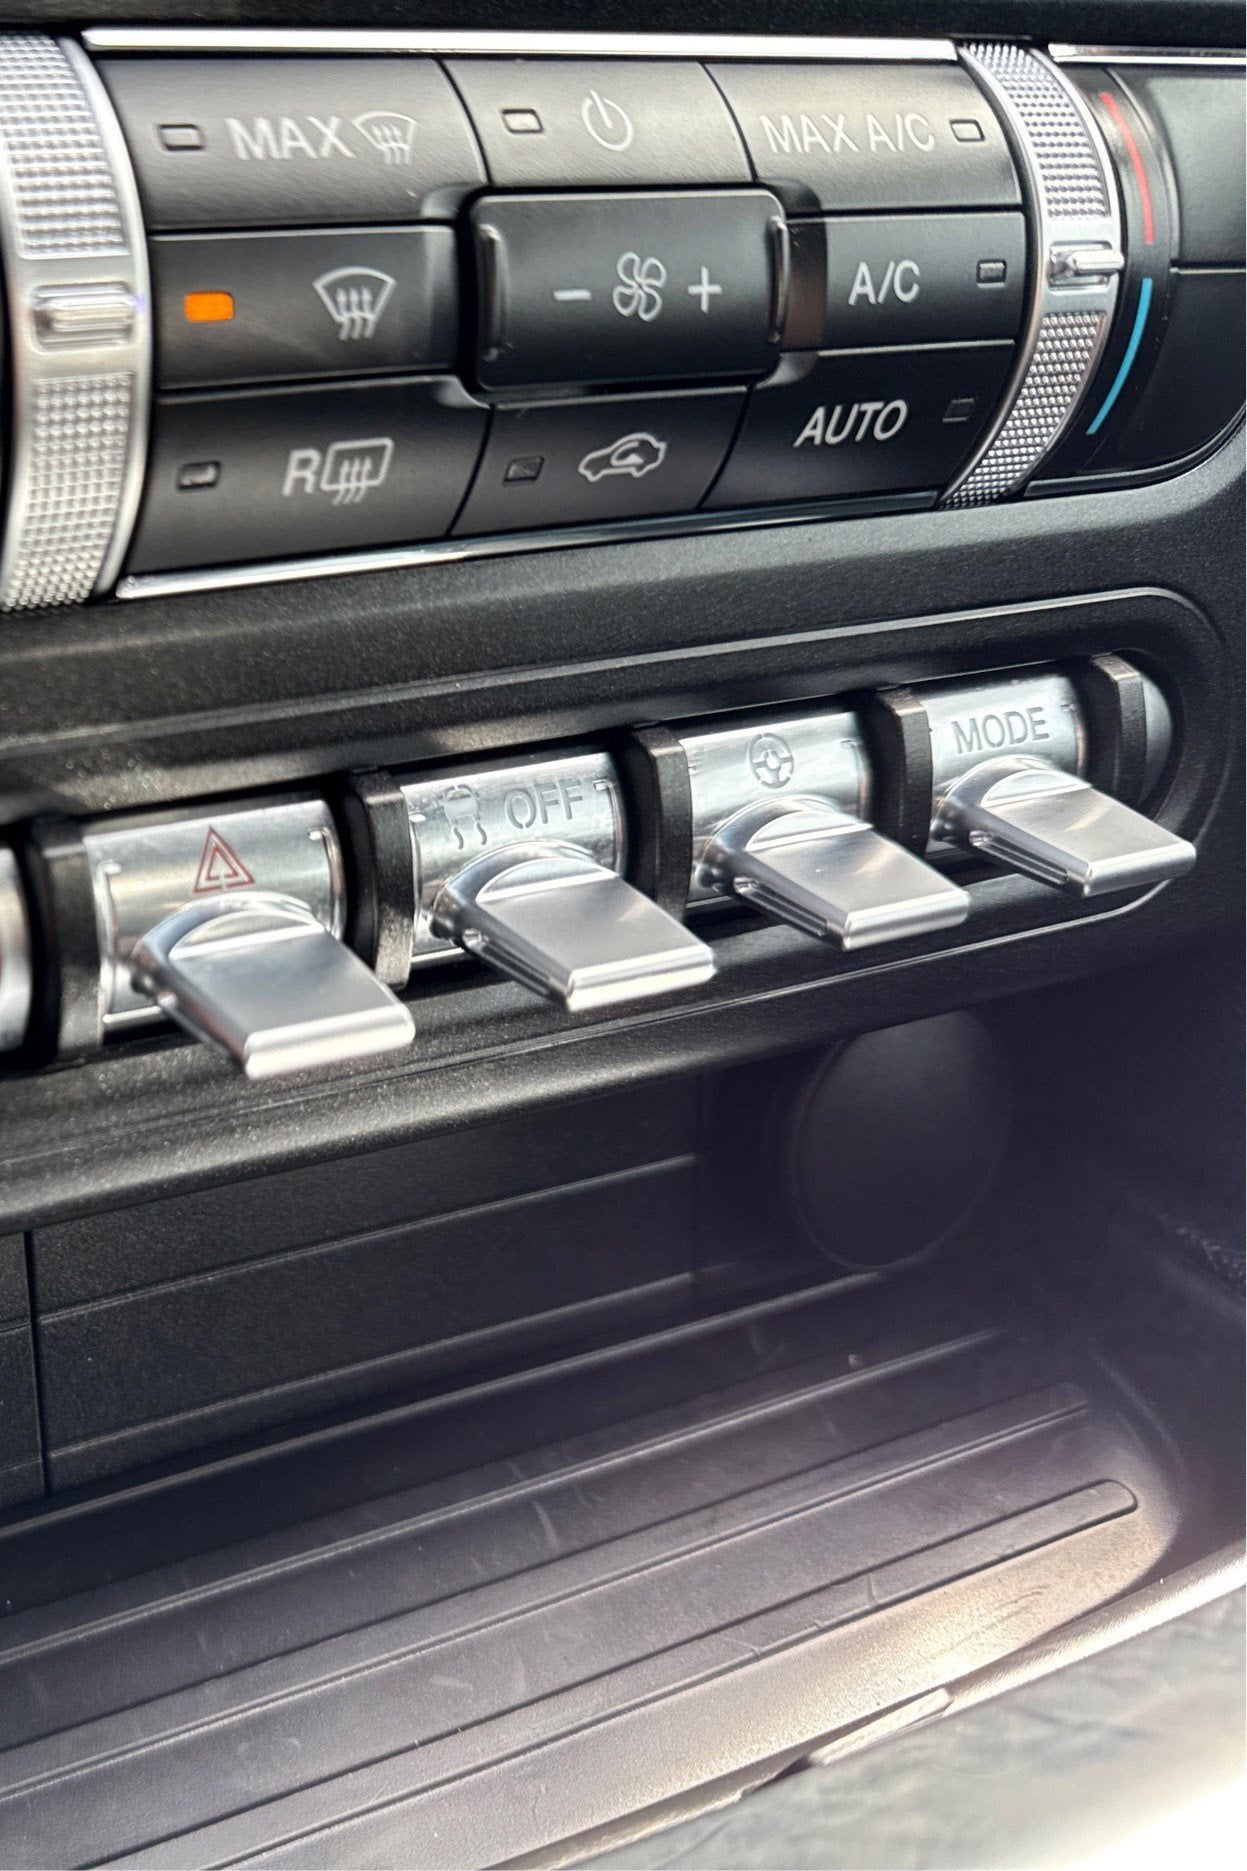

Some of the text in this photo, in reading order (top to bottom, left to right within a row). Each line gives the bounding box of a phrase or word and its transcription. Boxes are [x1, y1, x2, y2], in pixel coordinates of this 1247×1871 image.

[226, 115, 356, 160] MAX
[759, 113, 936, 153] MAX A/C
[847, 260, 922, 306] A/C
[792, 400, 909, 448] AUTO
[281, 448, 322, 497] R
[951, 705, 1051, 755] MODE
[503, 785, 584, 830] OFF
